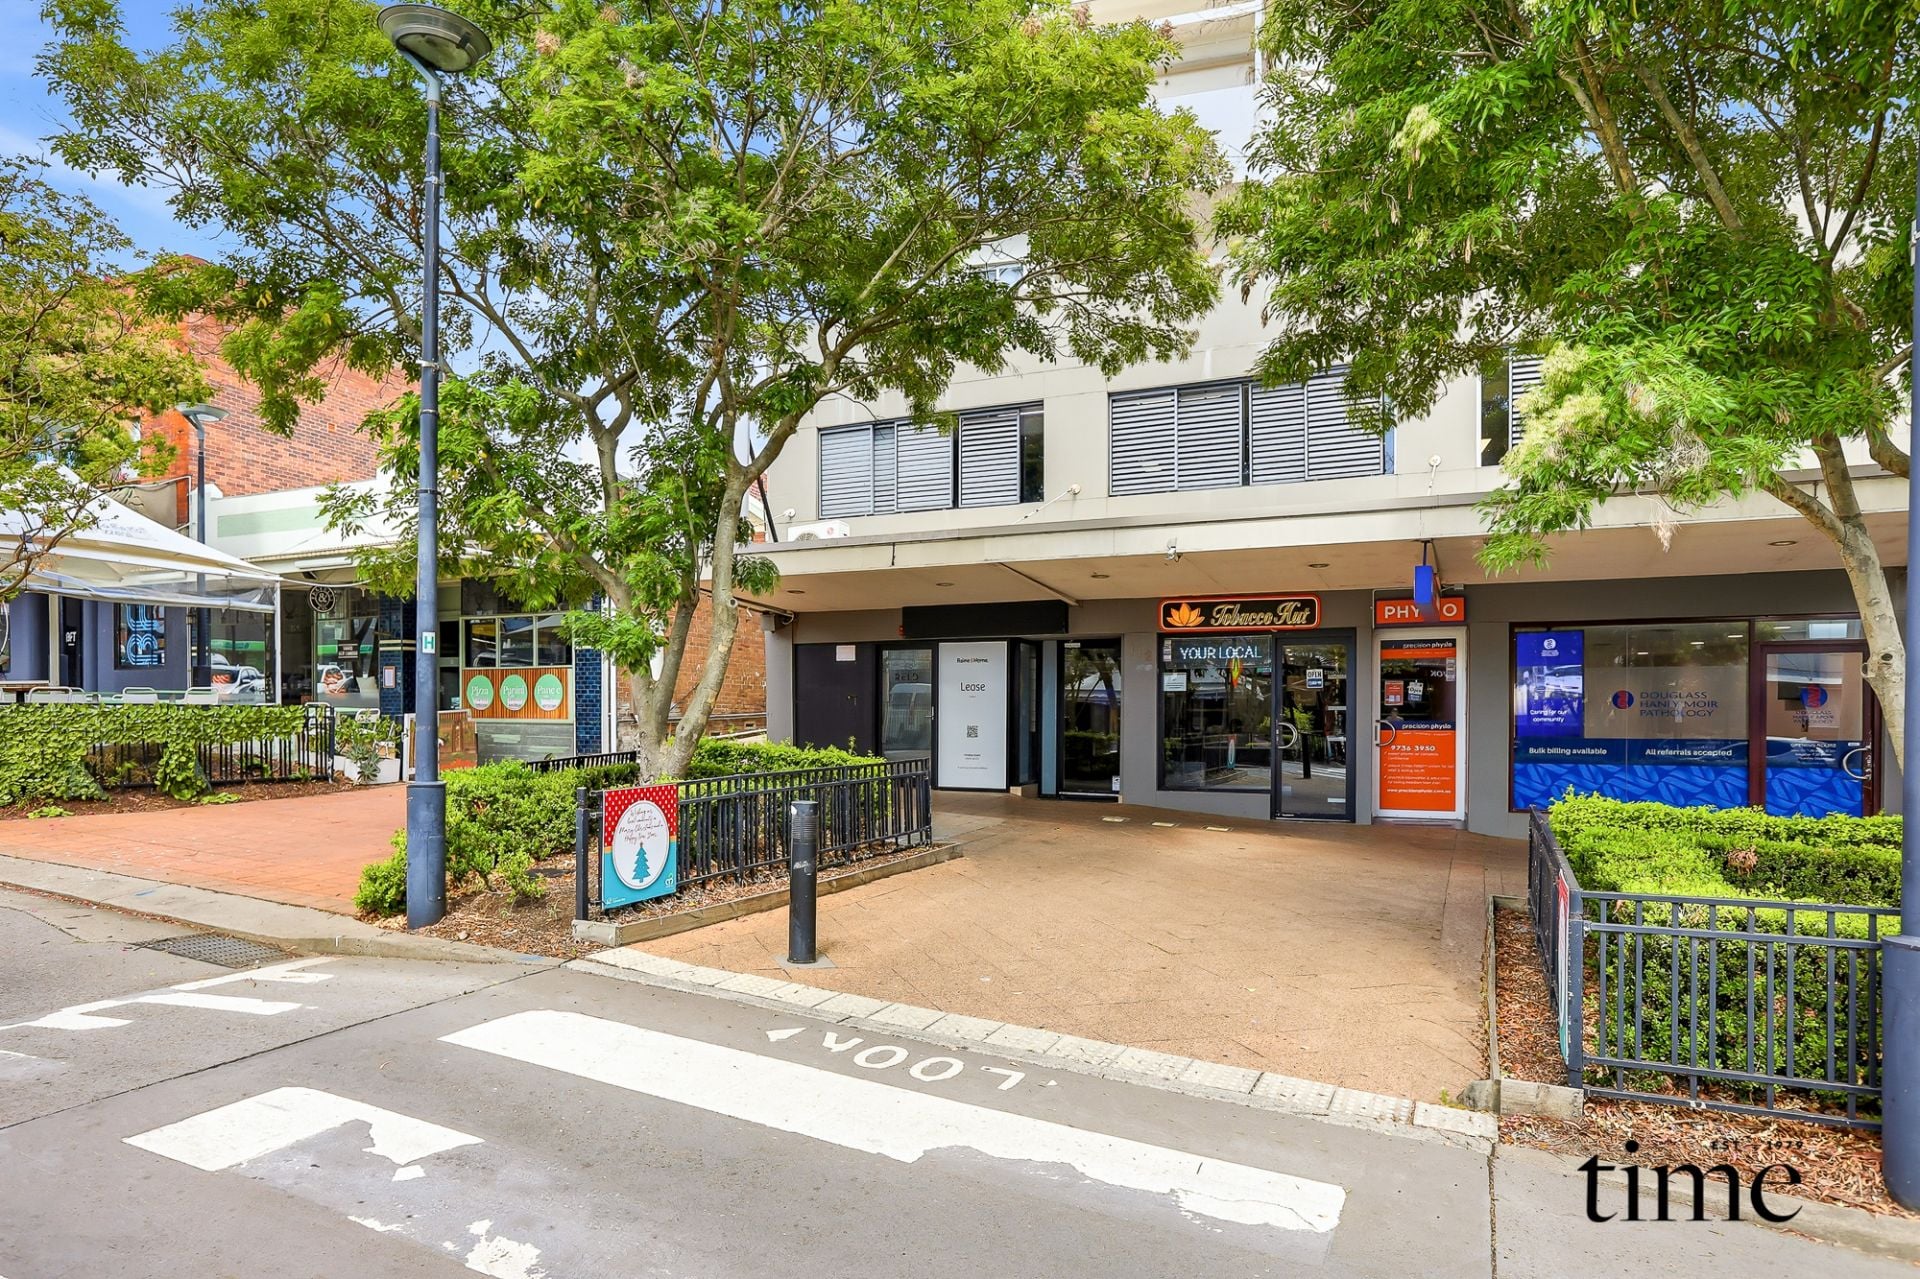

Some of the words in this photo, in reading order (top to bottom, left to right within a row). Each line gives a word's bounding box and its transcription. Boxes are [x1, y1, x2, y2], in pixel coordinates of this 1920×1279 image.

[1211, 603, 1274, 626] Tobacco
[1274, 601, 1311, 625] Hut
[1384, 603, 1458, 619] PHYO
[424, 636, 434, 650] H
[1431, 641, 1453, 649] physio
[1180, 646, 1217, 660] YOUR
[1219, 645, 1263, 659] LOCAL
[960, 681, 986, 692] Lease
[1640, 691, 1708, 700] DOUGLASS
[1683, 700, 1719, 708] MOIR
[1529, 709, 1548, 717] Caring
[1640, 709, 1715, 717] PATHOLOGY
[1402, 722, 1430, 730] precision
[1430, 722, 1452, 730] physio
[1529, 747, 1546, 755] Bulk
[1547, 747, 1571, 756] billing
[1572, 747, 1608, 755] available
[1645, 748, 1656, 756] All
[1657, 748, 1692, 756] referrals
[1692, 748, 1733, 757] accepted
